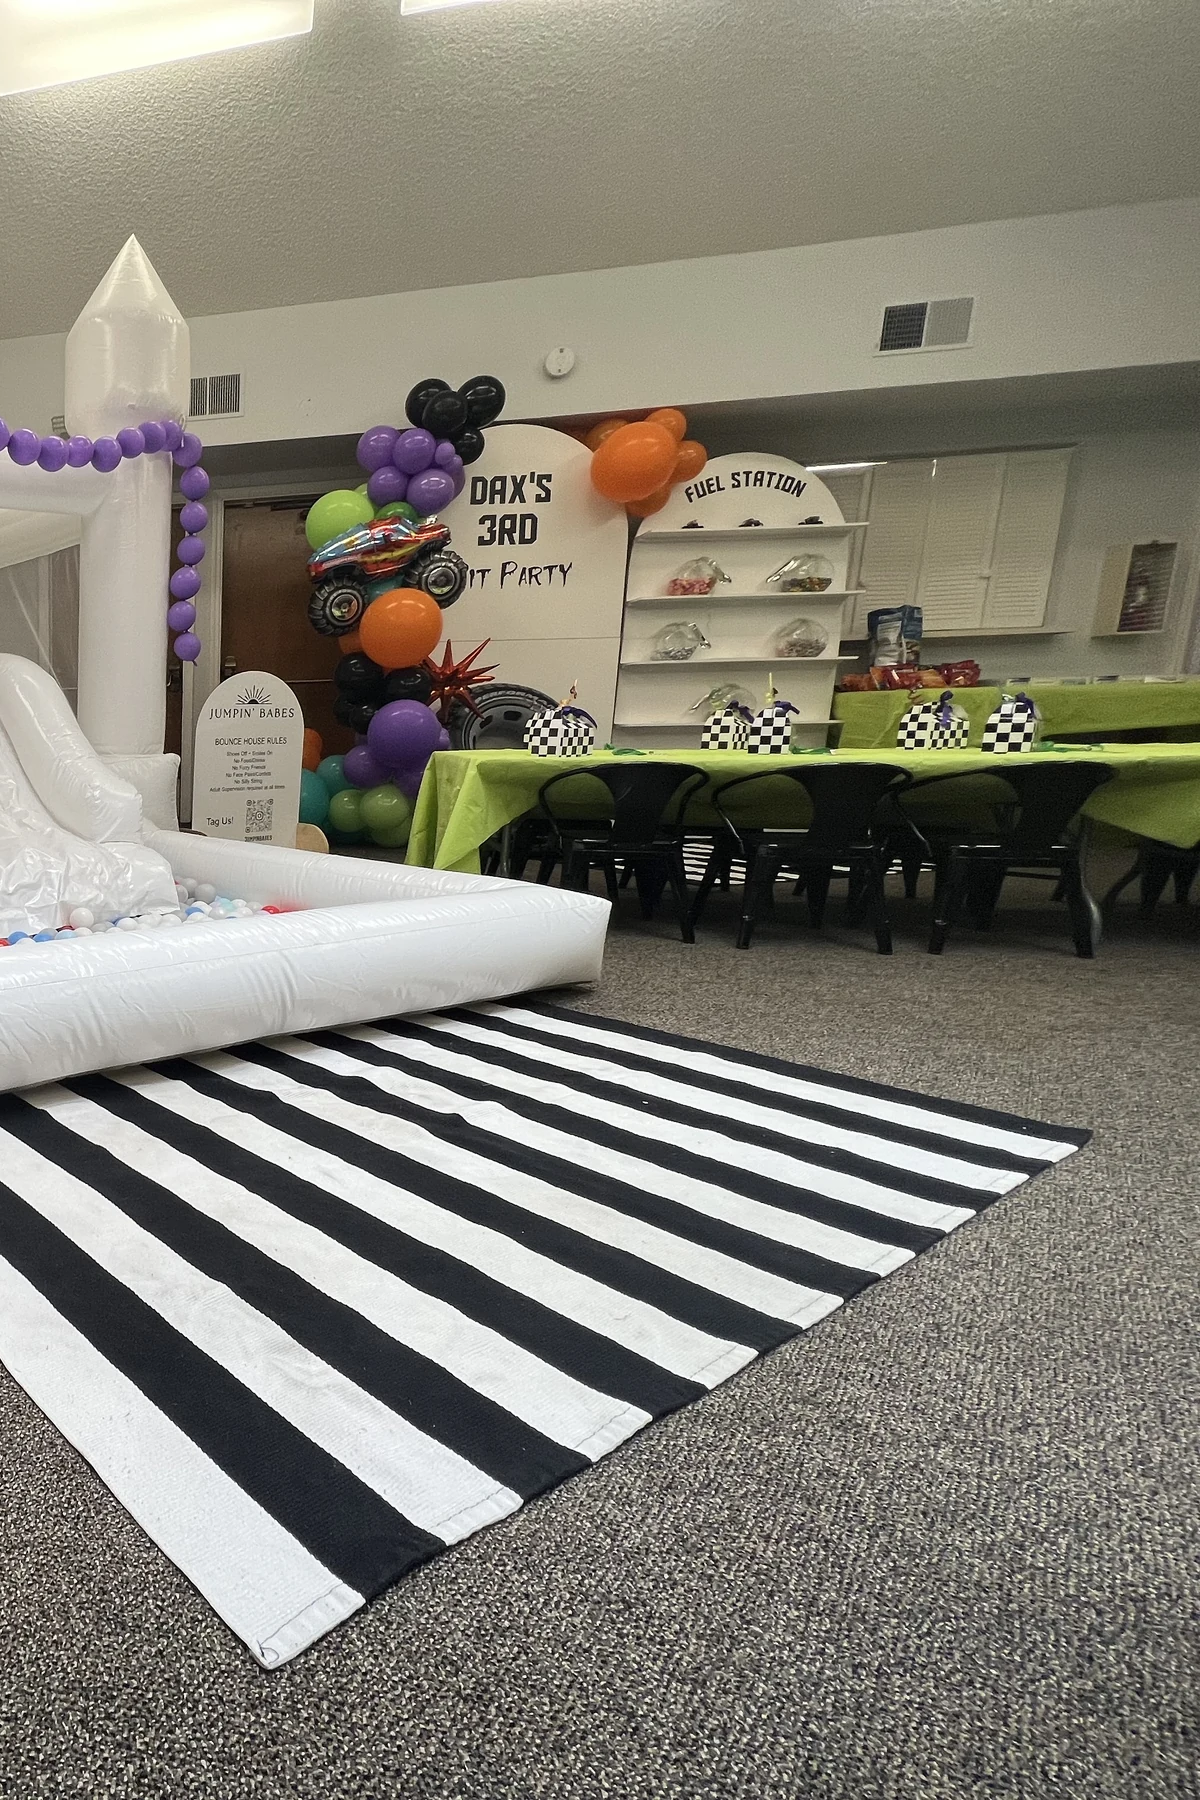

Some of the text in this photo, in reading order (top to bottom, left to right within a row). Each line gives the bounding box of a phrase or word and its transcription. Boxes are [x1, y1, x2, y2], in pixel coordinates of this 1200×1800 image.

[469, 471, 553, 505] DAX'S
[684, 470, 808, 503] FUEL STATION
[477, 513, 539, 547] 3RD
[469, 560, 573, 590] IT PARTY
[209, 707, 295, 720] JUMPIN' BABES
[214, 736, 288, 746] BOUNCE HOUSE RULES
[206, 816, 234, 828] Tag Us!
